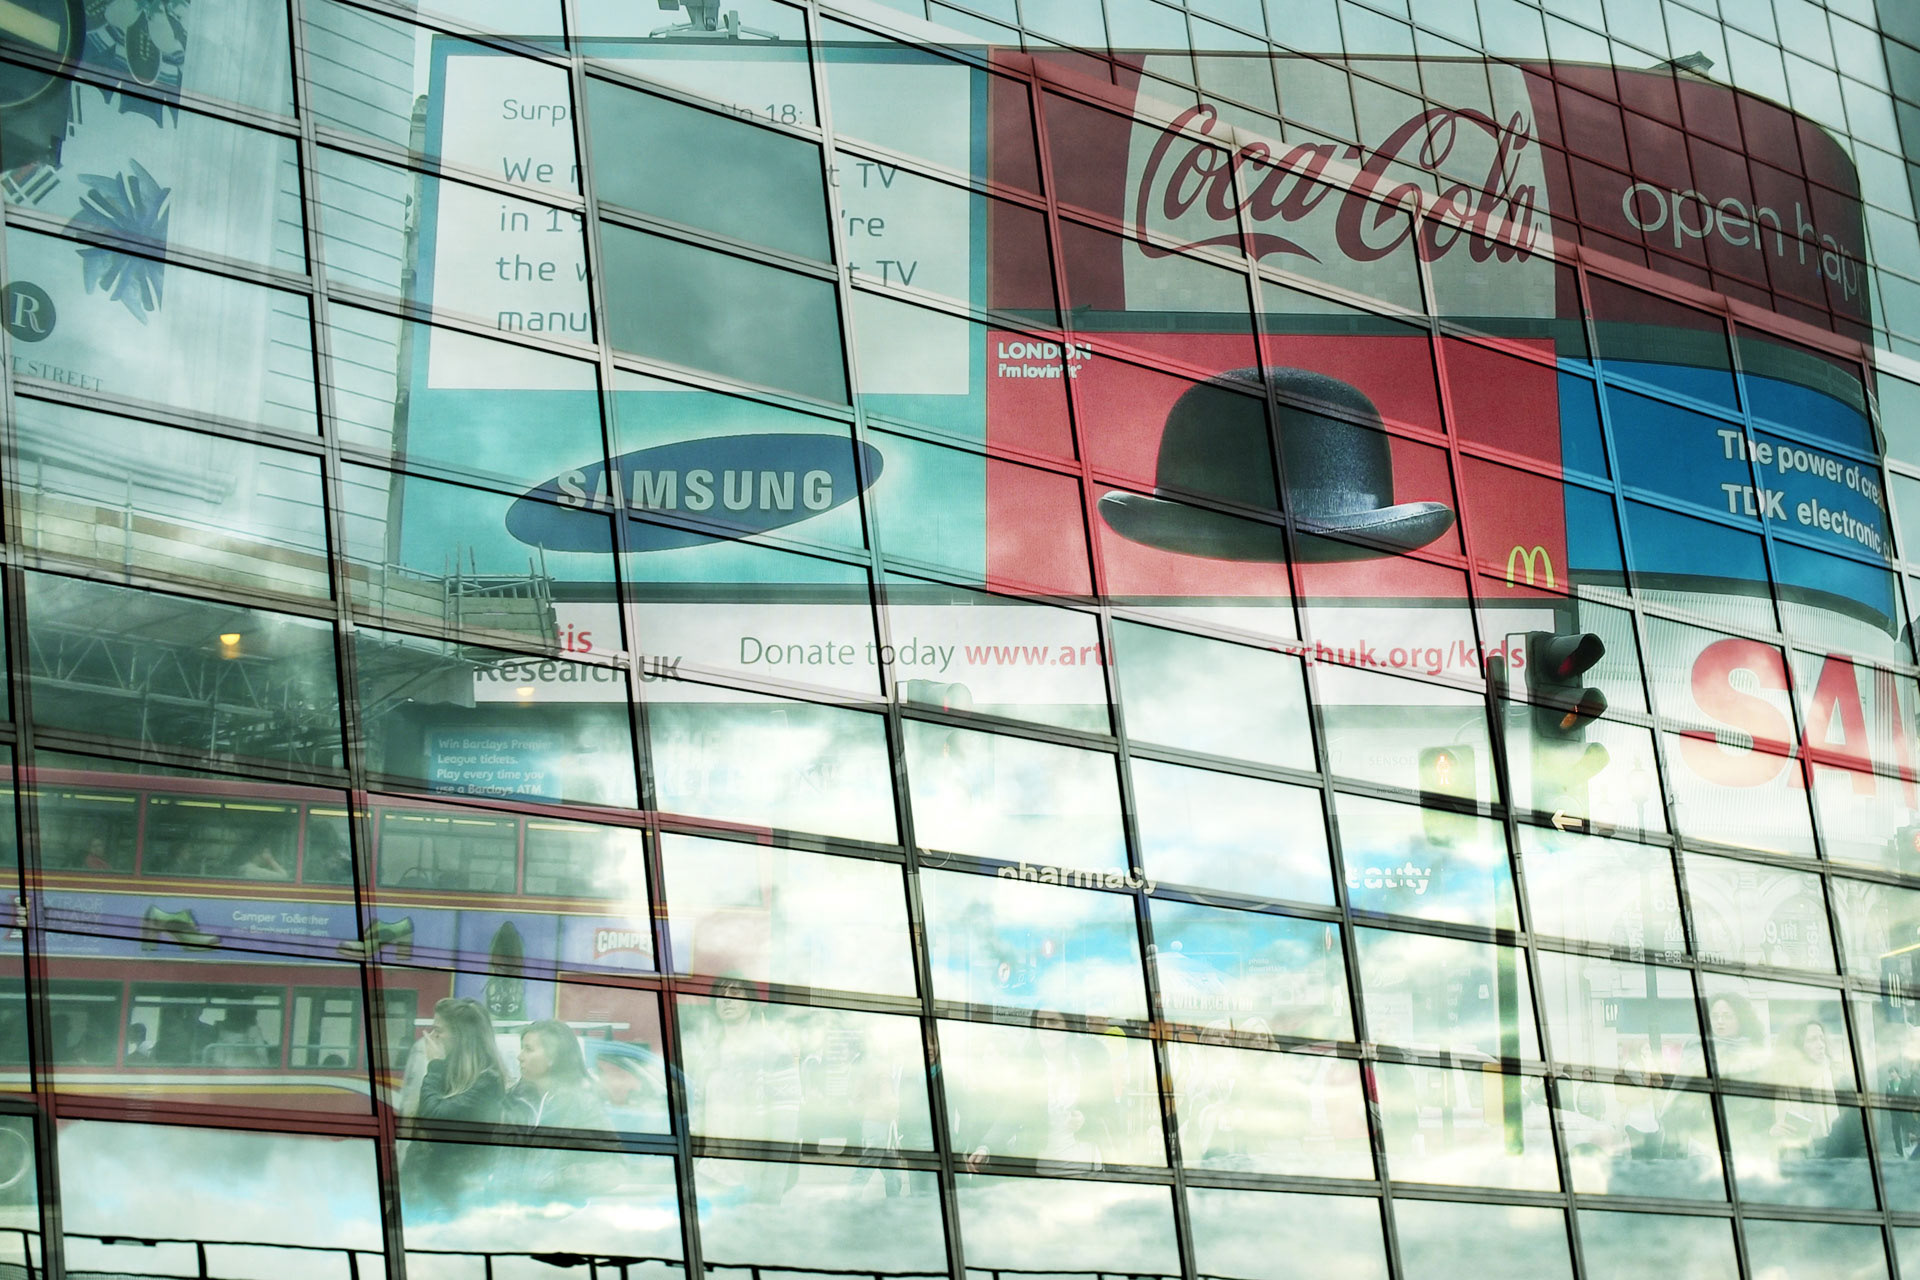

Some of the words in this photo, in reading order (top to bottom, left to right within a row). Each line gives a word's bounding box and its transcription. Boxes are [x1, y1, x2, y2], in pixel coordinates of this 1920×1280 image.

[502, 156, 554, 184] We
[855, 162, 898, 190] TV
[499, 205, 530, 233] in
[1621, 182, 1785, 258] open
[496, 253, 557, 282] the
[874, 260, 918, 288] TV
[497, 310, 590, 332] manu
[998, 342, 1092, 361] LONDON
[26, 360, 104, 393] STREET
[1717, 429, 1773, 466] The
[1777, 445, 1844, 484] power
[1845, 465, 1861, 493] of
[556, 469, 834, 511] SAMSUNG
[1720, 483, 1788, 521] TDK
[637, 656, 685, 684] UK
[740, 636, 857, 668] Donate
[866, 637, 956, 674] today
[437, 754, 477, 766] League
[479, 754, 519, 765] tickets.
[438, 739, 460, 750] Win
[462, 739, 509, 752] Barclays
[511, 739, 553, 751] Premier
[436, 769, 461, 782] Play
[463, 770, 495, 782] every
[496, 770, 521, 780] time
[524, 770, 545, 782] you
[457, 786, 465, 794] a
[468, 784, 514, 797] Barclays
[997, 861, 1157, 894] pharmacy
[1346, 861, 1431, 896] eauty
[232, 910, 276, 925] Camper
[597, 931, 653, 953] CAMPE
